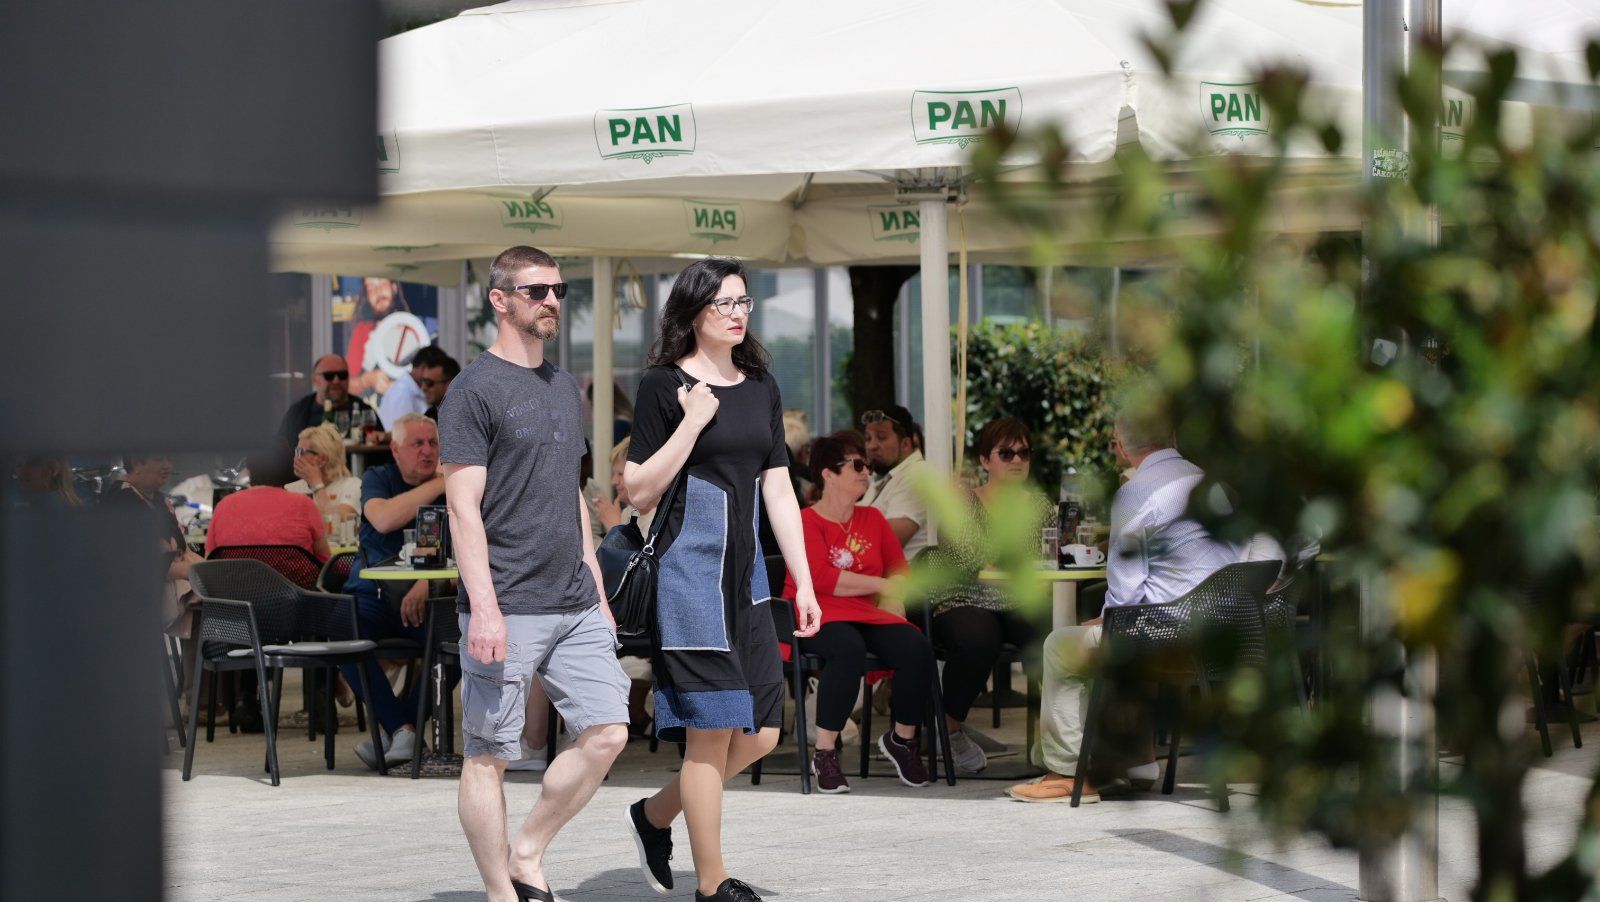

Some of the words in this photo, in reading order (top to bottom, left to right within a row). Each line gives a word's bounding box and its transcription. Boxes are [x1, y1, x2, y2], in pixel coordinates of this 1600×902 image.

[927, 99, 1006, 130] PAN
[1210, 93, 1261, 122] PAN
[607, 114, 682, 146] PAN
